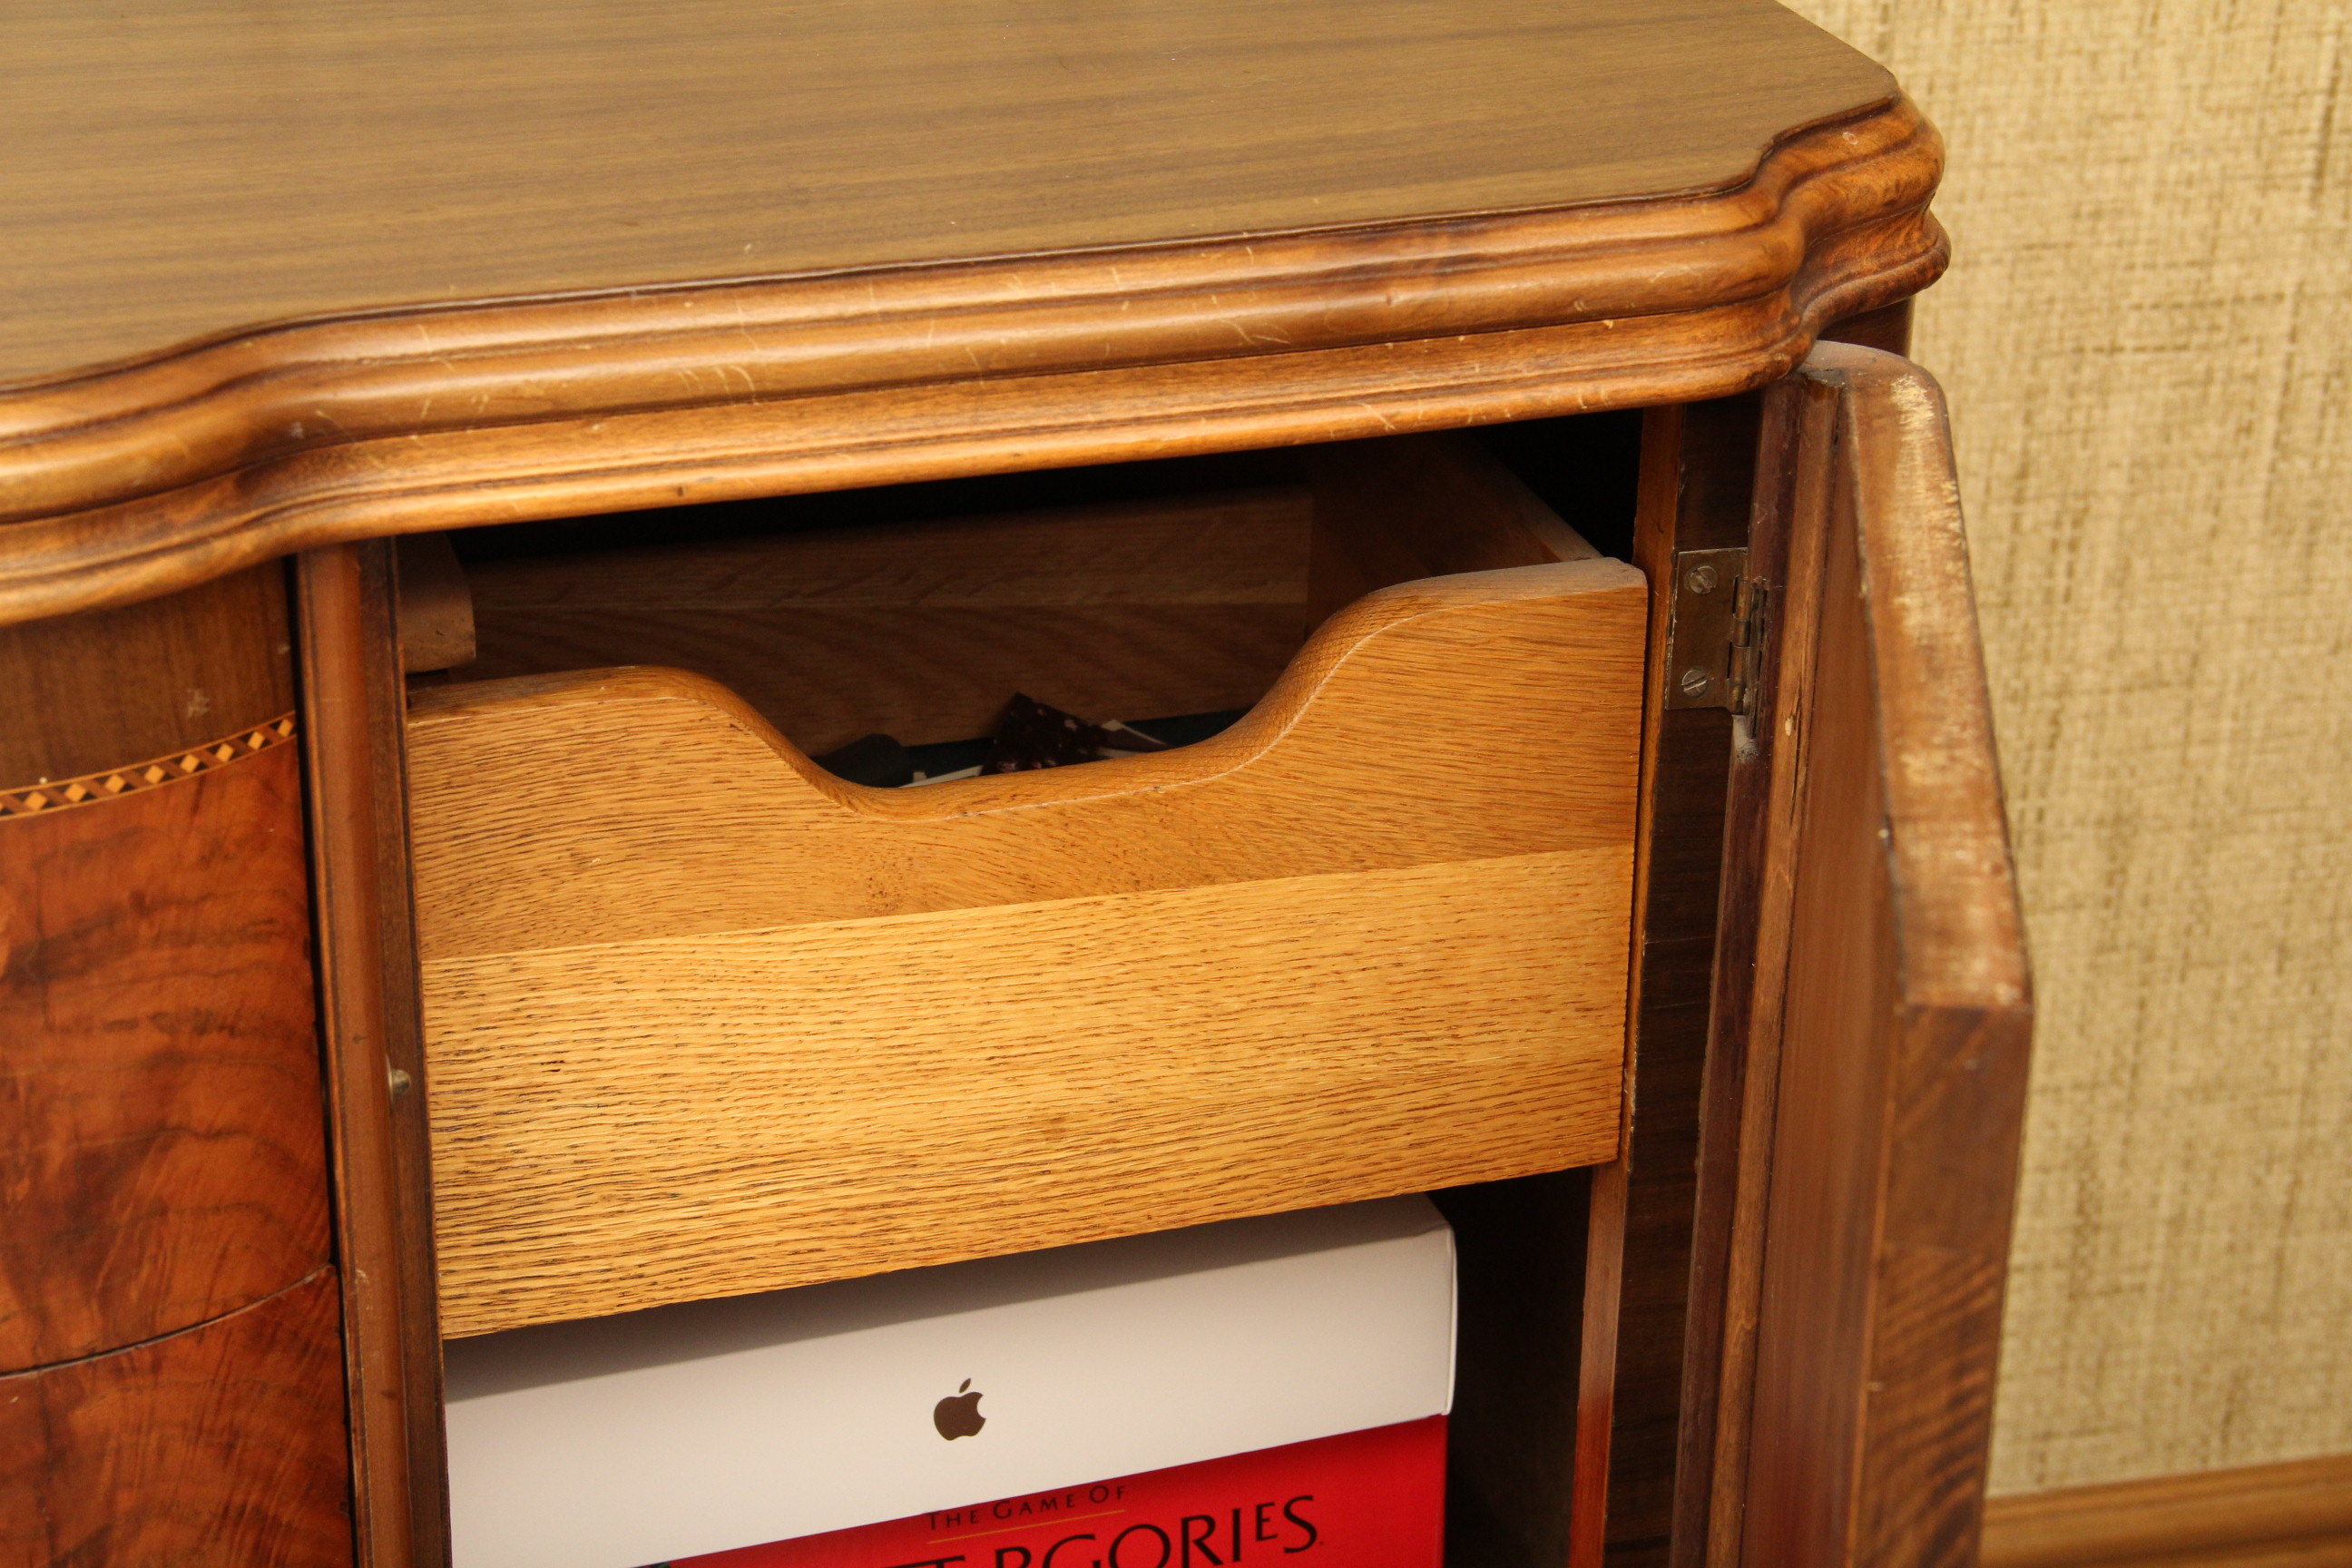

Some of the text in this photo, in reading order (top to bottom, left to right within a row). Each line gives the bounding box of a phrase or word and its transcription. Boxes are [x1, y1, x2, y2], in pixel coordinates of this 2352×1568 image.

[926, 1485, 1126, 1531] THE GAME OF
